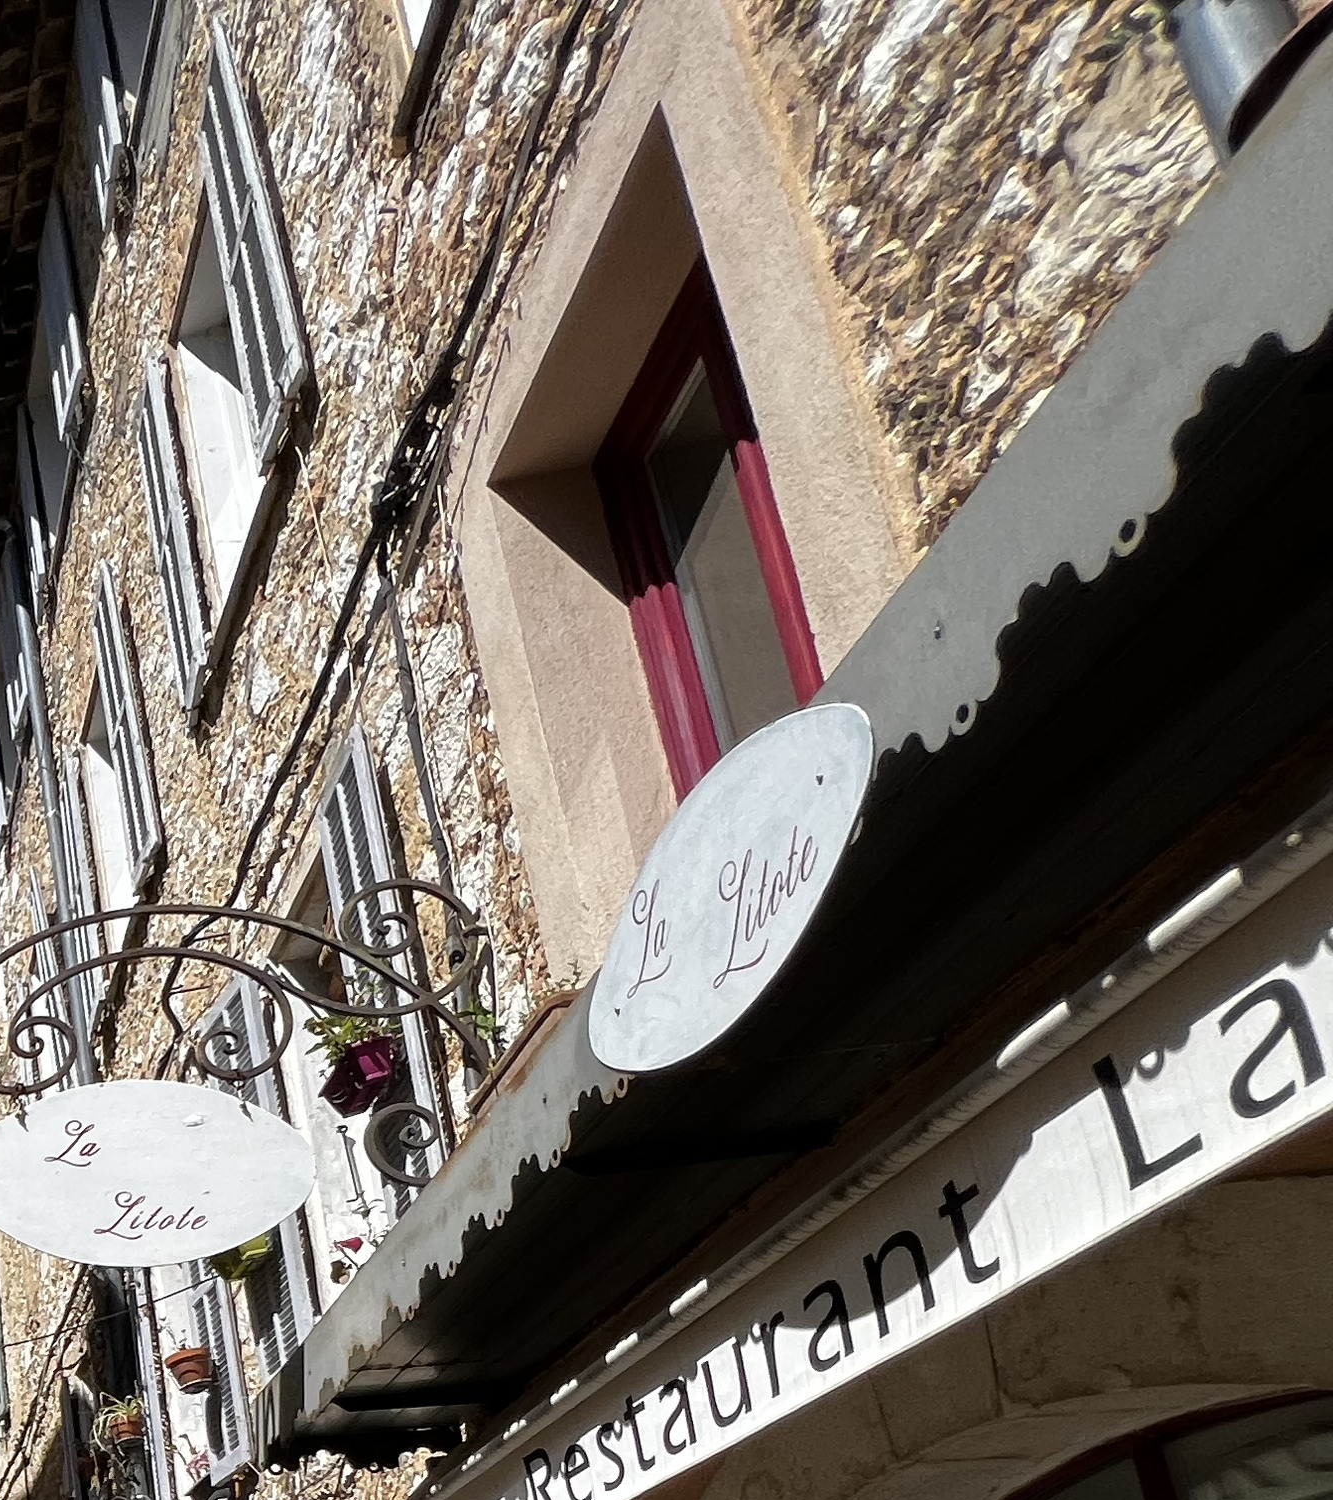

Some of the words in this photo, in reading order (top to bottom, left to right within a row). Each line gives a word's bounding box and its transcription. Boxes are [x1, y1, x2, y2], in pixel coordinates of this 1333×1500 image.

[625, 877, 672, 999] La
[711, 823, 821, 990] Litote
[1091, 977, 1327, 1191] La
[43, 1118, 101, 1168] La
[92, 1189, 210, 1241] Litote
